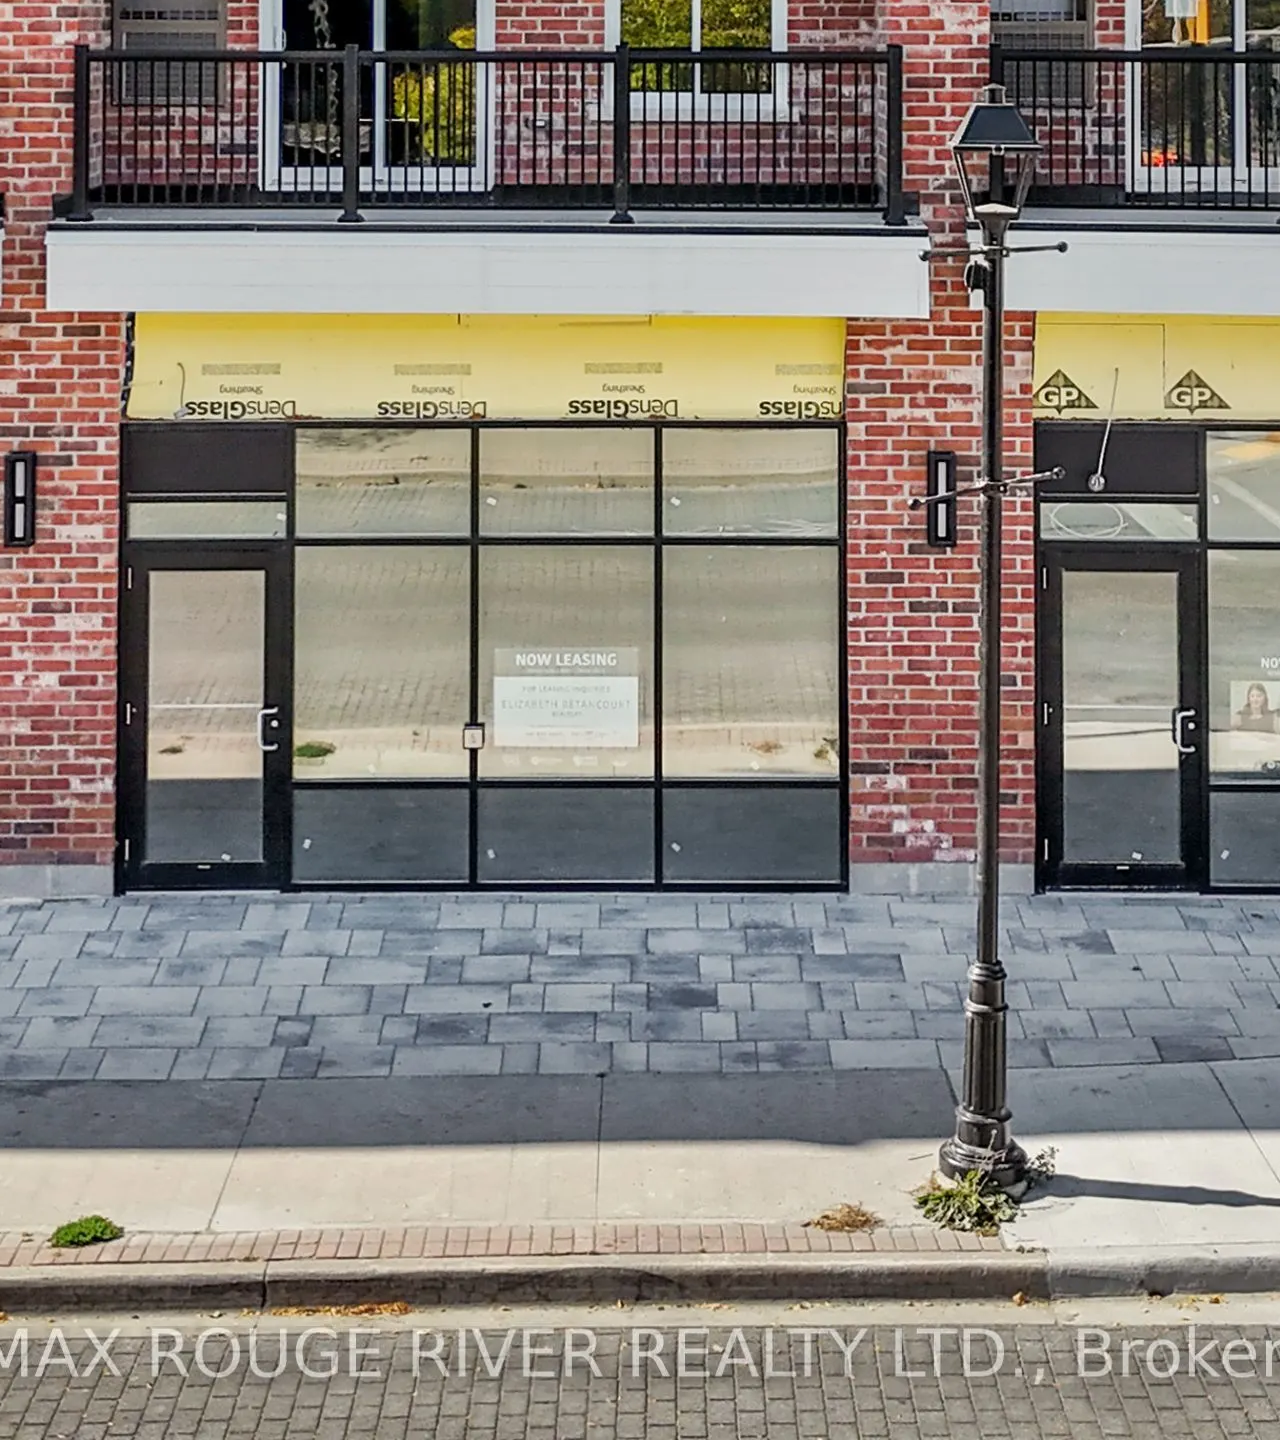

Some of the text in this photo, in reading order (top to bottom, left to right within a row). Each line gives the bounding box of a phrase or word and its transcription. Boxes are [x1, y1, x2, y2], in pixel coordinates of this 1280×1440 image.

[219, 385, 263, 395] Sheathing
[411, 385, 455, 395] Sheathing
[602, 384, 645, 394] Sheathing
[793, 385, 837, 395] Sheathing
[1038, 386, 1079, 407] GP
[1170, 386, 1212, 407] GP
[186, 400, 297, 419] DensGlass
[377, 400, 487, 419] DensGlass
[568, 399, 679, 418] DensGlass
[515, 652, 618, 667] NOW LEASING
